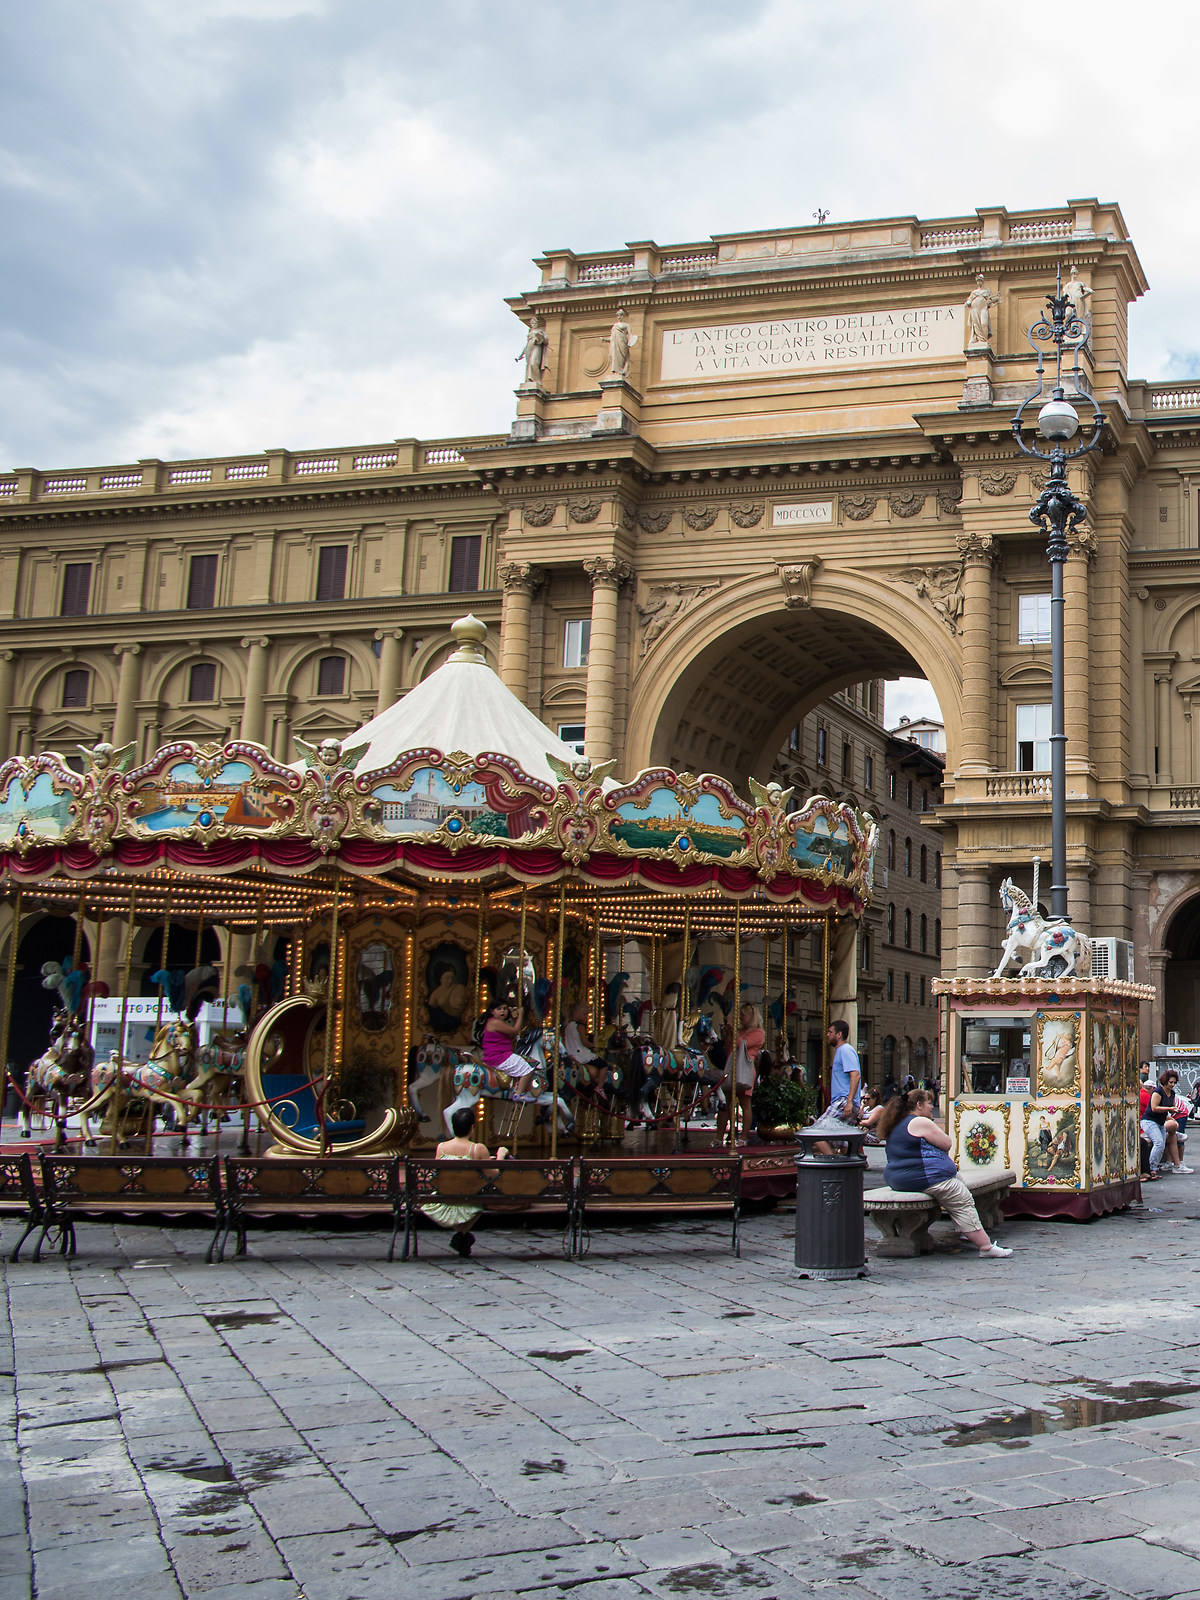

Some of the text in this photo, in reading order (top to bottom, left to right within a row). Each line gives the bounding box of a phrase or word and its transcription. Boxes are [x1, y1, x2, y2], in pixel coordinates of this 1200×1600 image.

[691, 327, 752, 343] ANTICO
[758, 319, 828, 336] CENTRO
[835, 314, 895, 330] DELLA
[695, 325, 929, 357] DA SECOLARE SQUALLORE
[694, 340, 930, 371] A VITA NUOVA RESTITUITO
[775, 507, 829, 520] MDCCCXCV
[116, 1004, 144, 1014] IFO
